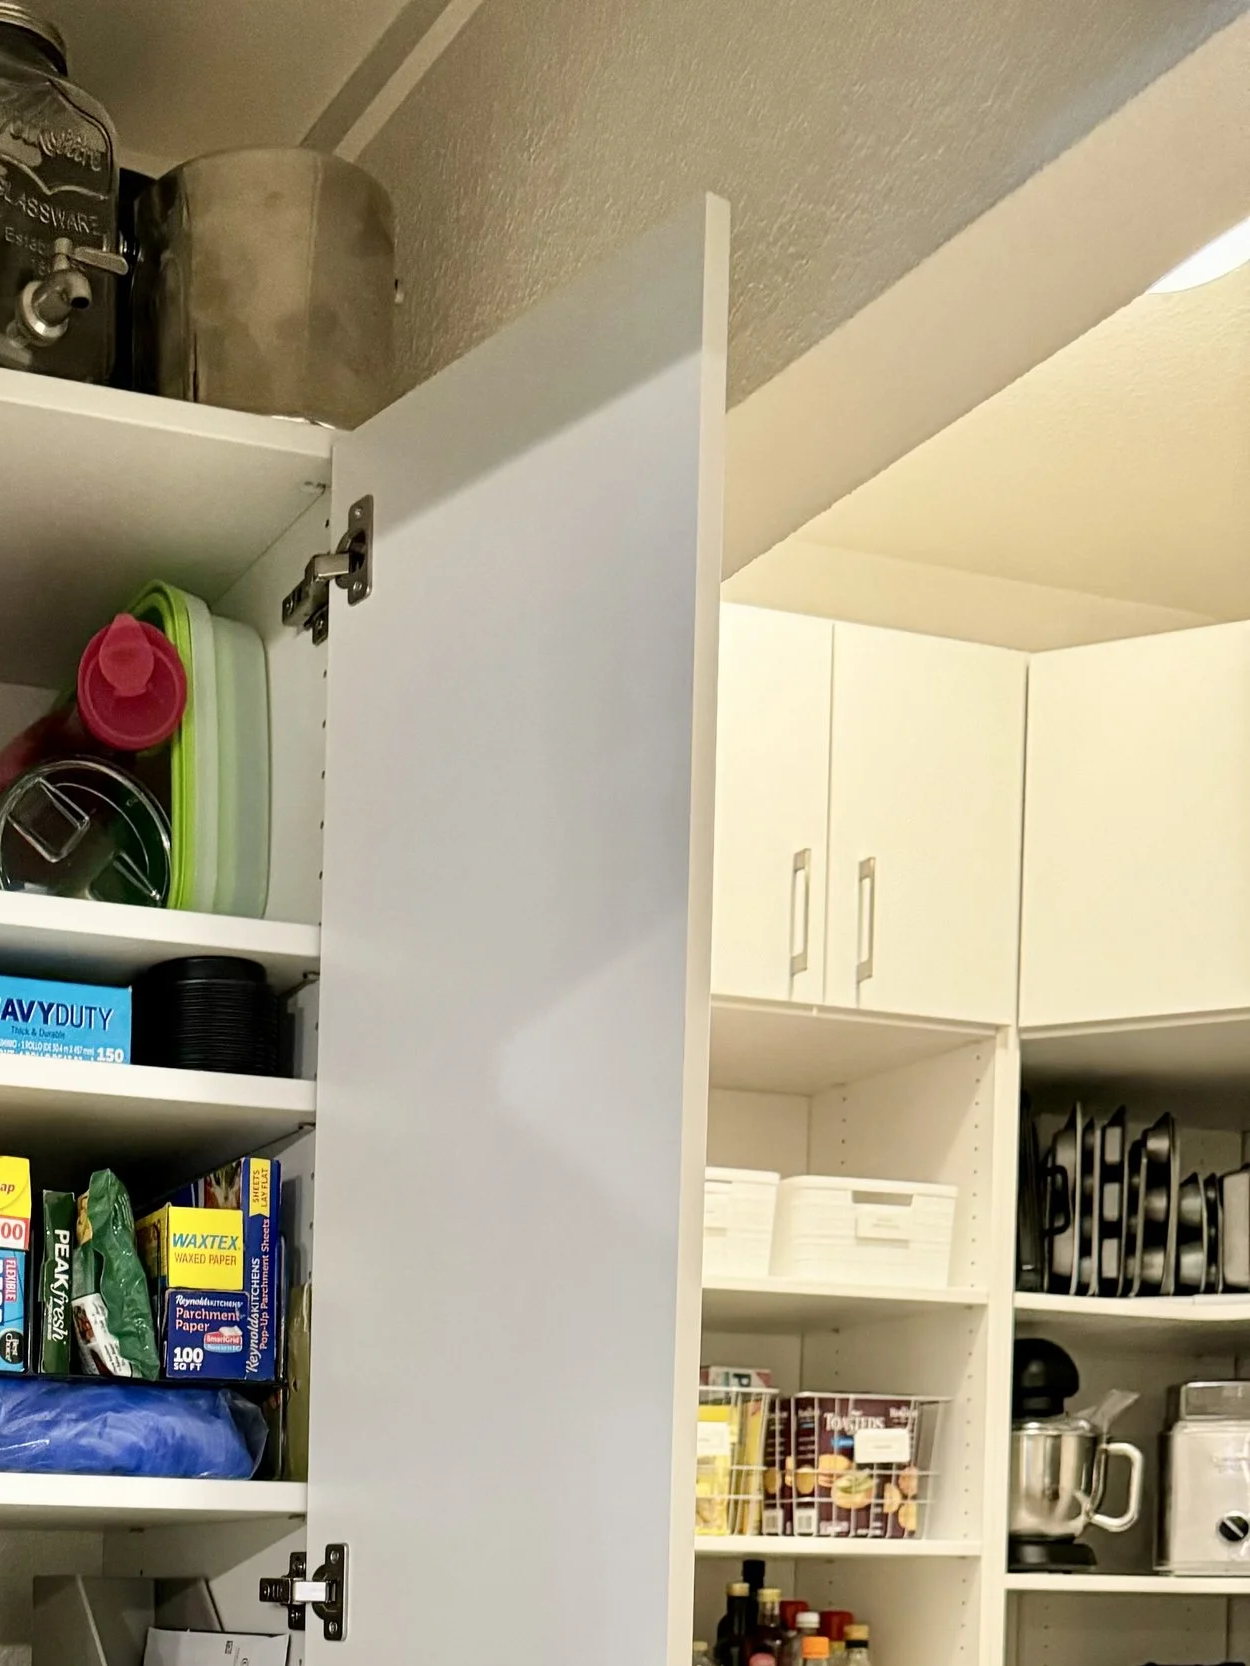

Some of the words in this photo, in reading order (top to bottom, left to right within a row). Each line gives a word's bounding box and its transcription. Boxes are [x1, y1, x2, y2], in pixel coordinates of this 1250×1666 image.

[11, 1025, 30, 1036] Thick
[39, 1028, 66, 1040] Durable
[97, 1047, 124, 1063] 150
[172, 1233, 240, 1250] WAXTEX
[261, 1218, 270, 1252] Sheets
[175, 1252, 207, 1265] WAXED
[208, 1254, 237, 1266] PAPER
[5, 1258, 17, 1301] FLEXIBLE
[260, 1255, 270, 1310] Parchment
[176, 1308, 240, 1321] Parchment
[175, 1321, 210, 1333] Paper
[260, 1312, 270, 1350] Pop-Up
[173, 1347, 204, 1363] 100
[173, 1363, 187, 1371] SQ
